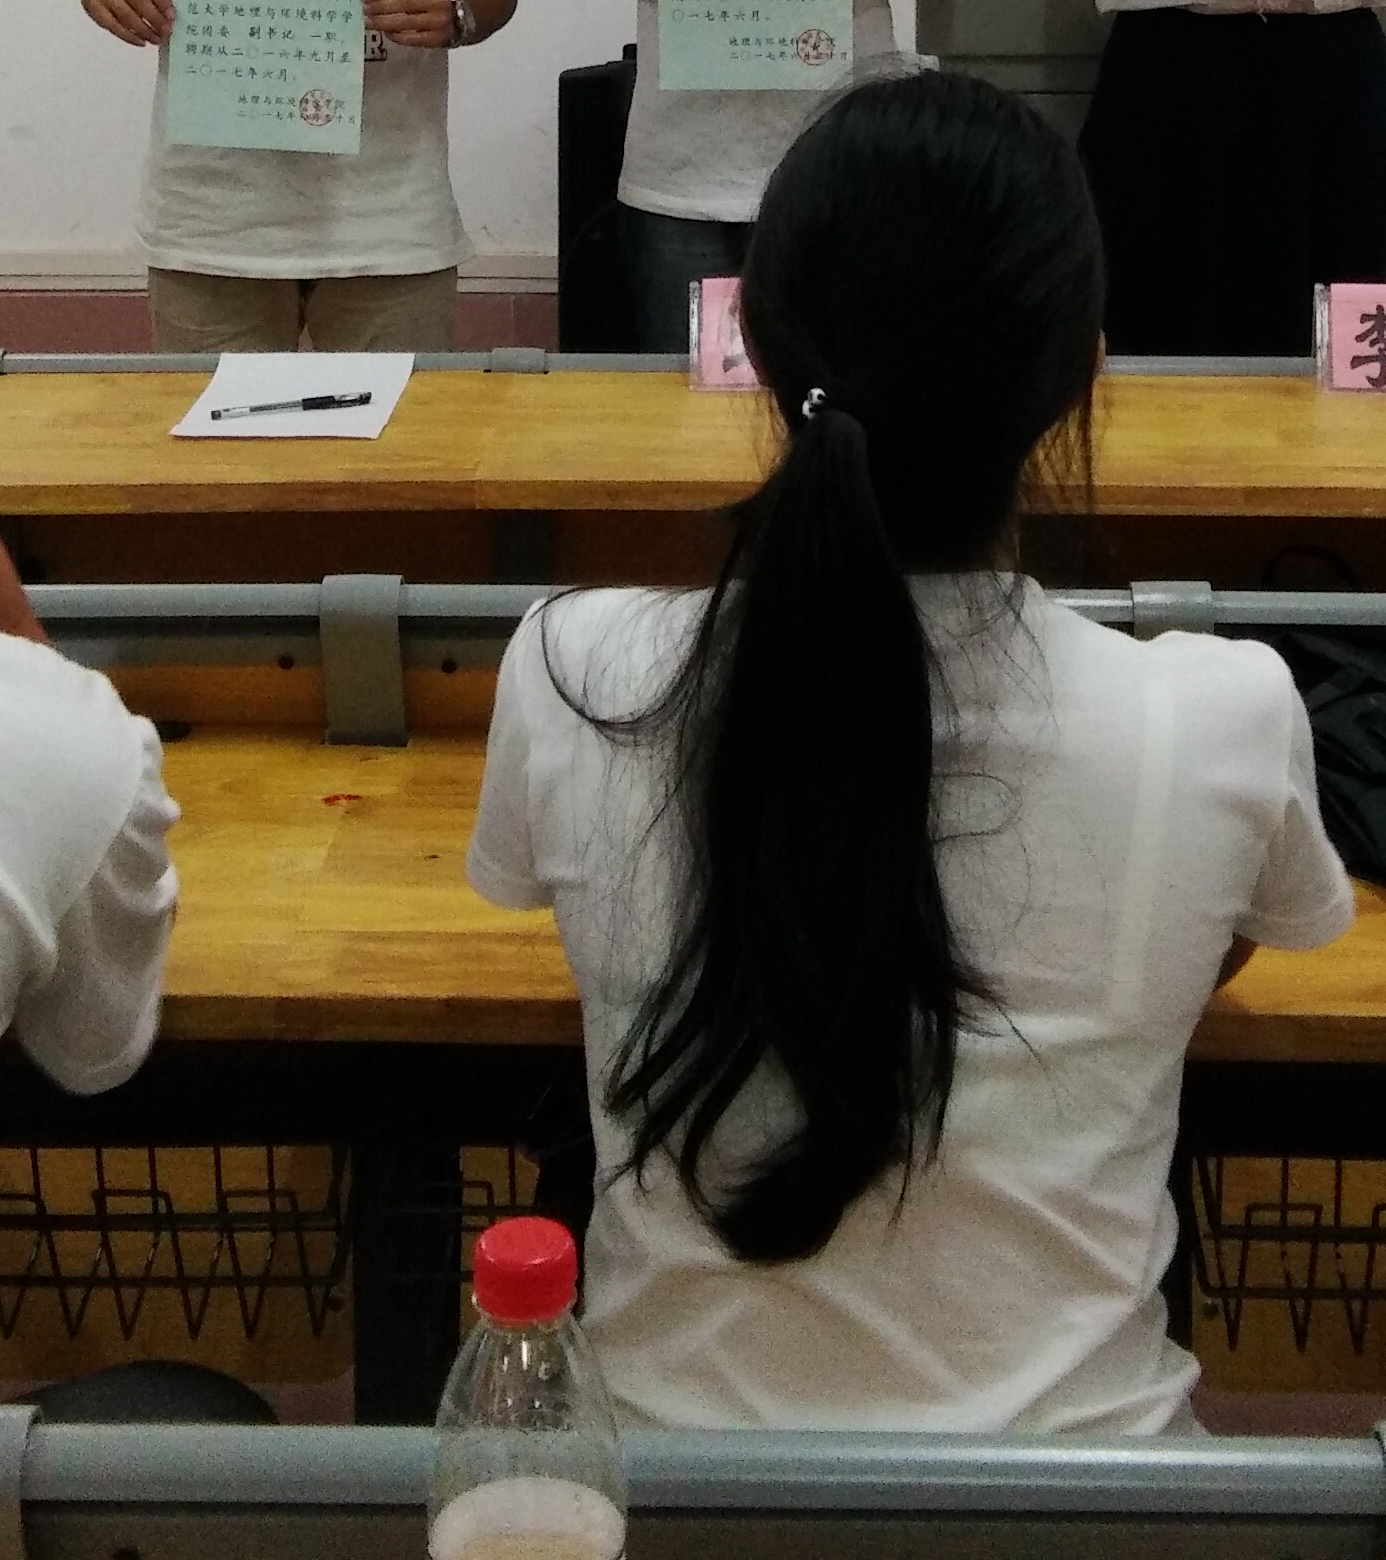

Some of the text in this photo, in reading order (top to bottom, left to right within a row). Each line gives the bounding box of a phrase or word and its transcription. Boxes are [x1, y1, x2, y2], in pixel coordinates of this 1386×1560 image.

[186, 1, 354, 24] 范大学地理与环境科学学
[248, 25, 295, 40] 副书记
